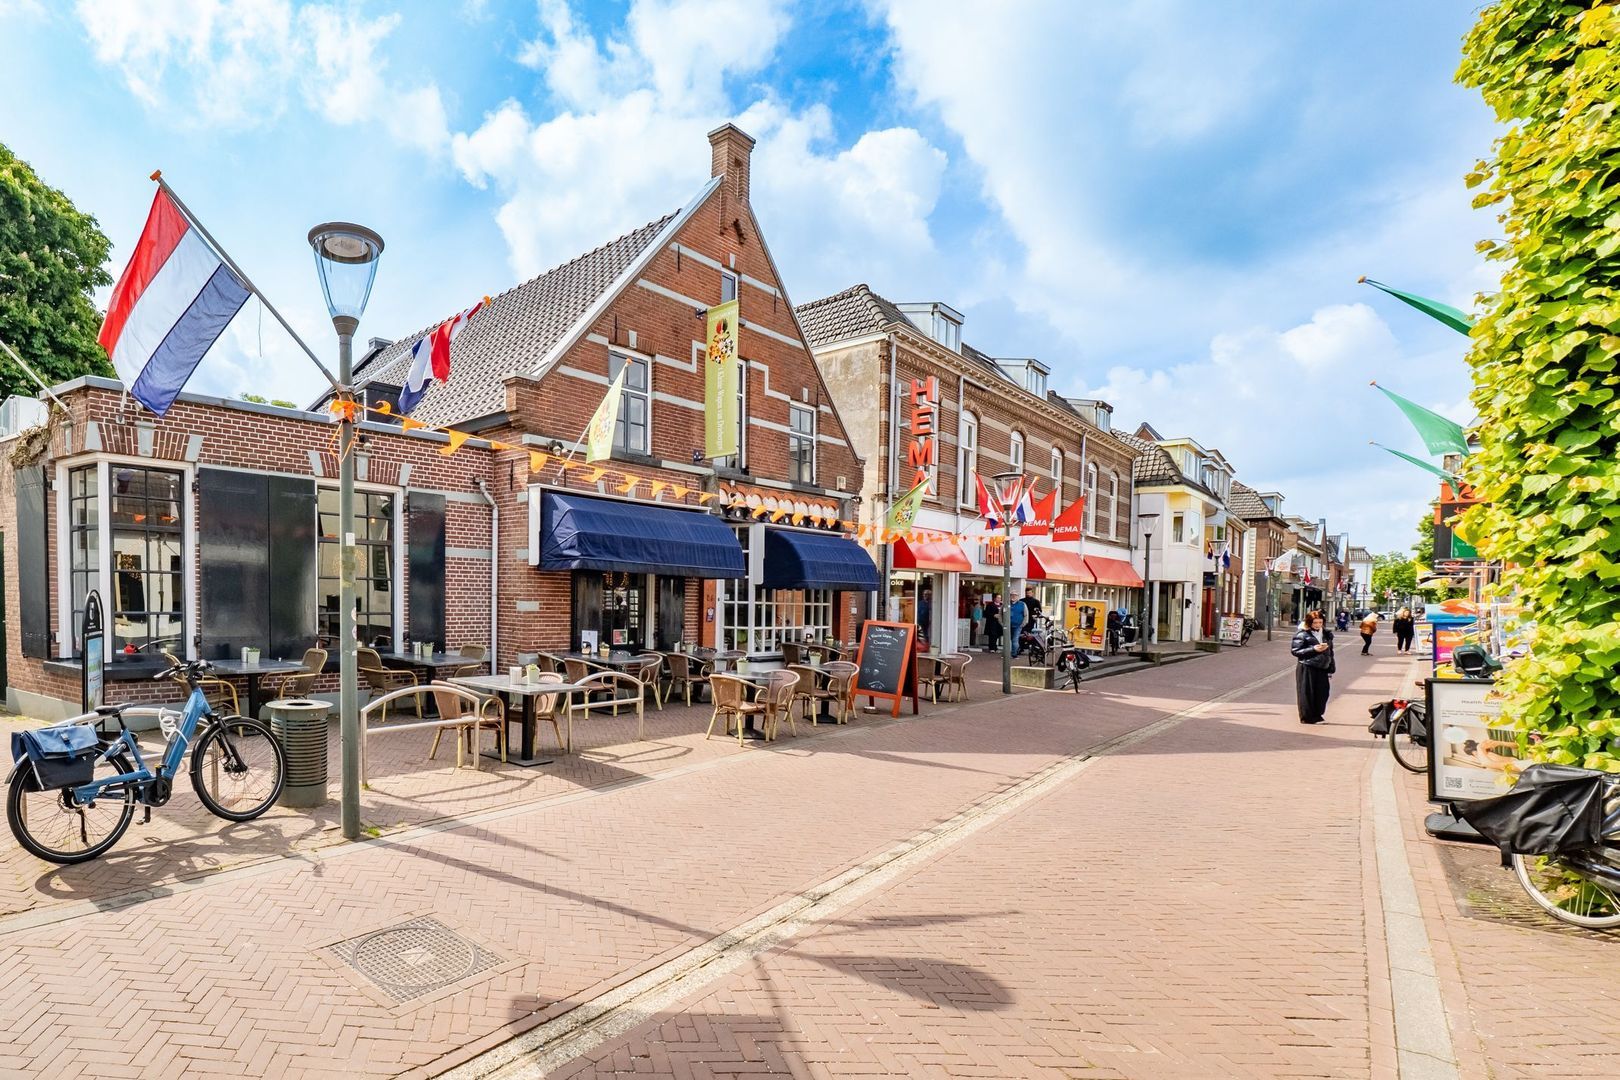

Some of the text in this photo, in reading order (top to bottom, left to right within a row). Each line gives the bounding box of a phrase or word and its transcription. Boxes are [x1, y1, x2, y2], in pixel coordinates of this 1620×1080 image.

[908, 375, 936, 496] HEMA
[1022, 519, 1047, 527] HEMA
[1053, 525, 1079, 534] HEMA
